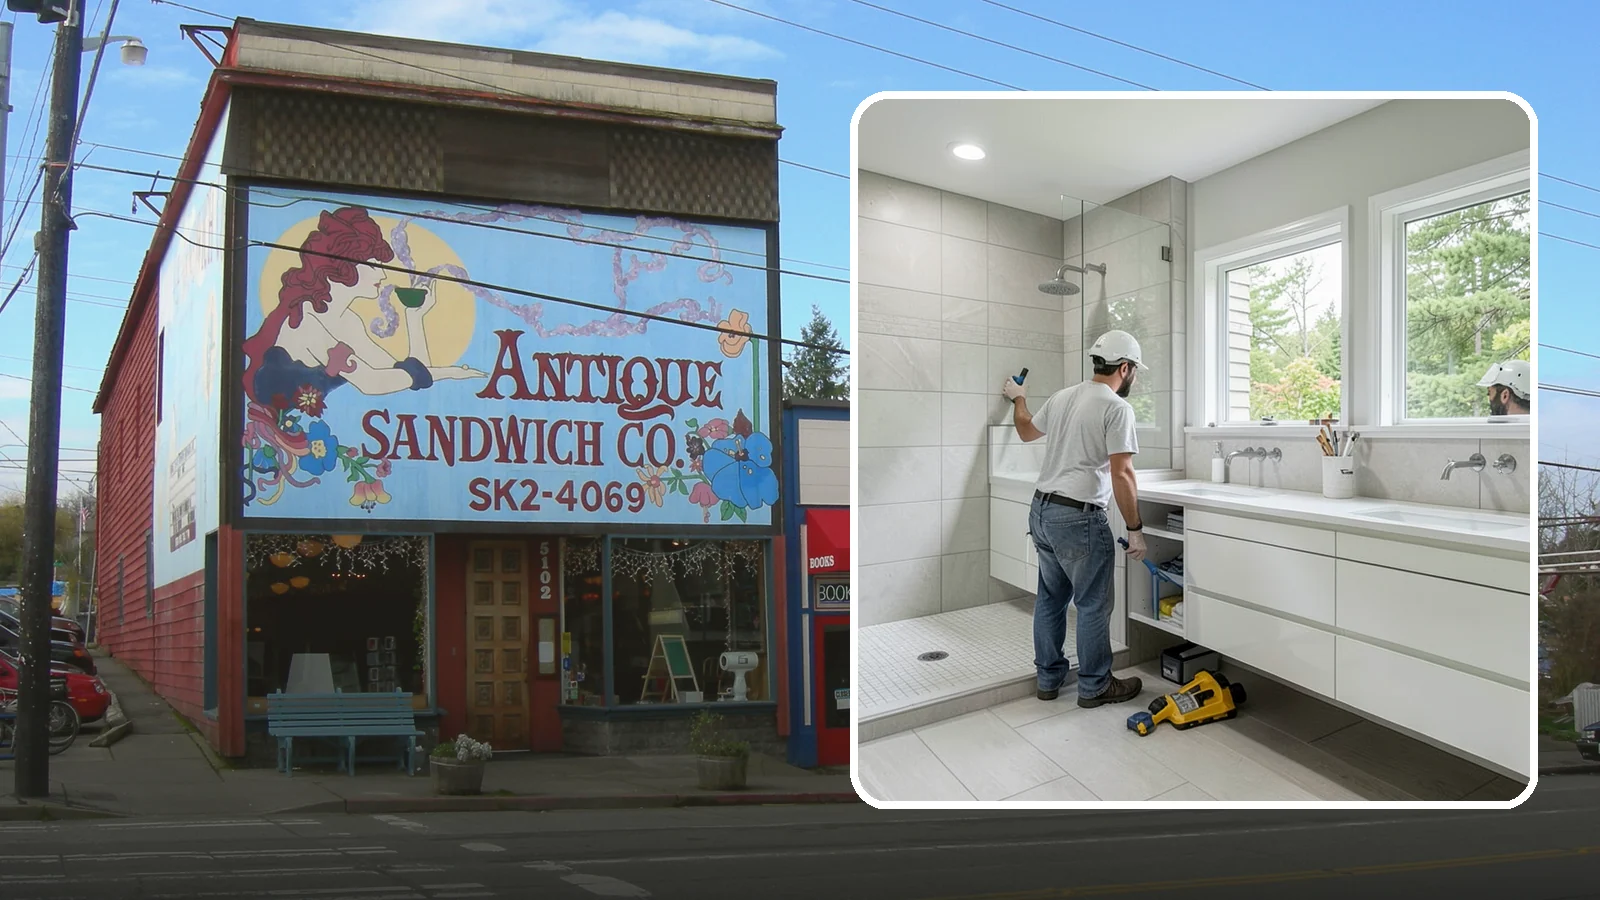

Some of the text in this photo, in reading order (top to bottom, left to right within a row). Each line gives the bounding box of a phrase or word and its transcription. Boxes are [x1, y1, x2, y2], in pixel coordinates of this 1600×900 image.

[476, 329, 724, 420] ANTIQUE
[361, 409, 685, 468] SANDWICH CO.
[468, 478, 646, 512] SK2-4069
[539, 541, 552, 600] 5102
[809, 555, 835, 569] BOOKS
